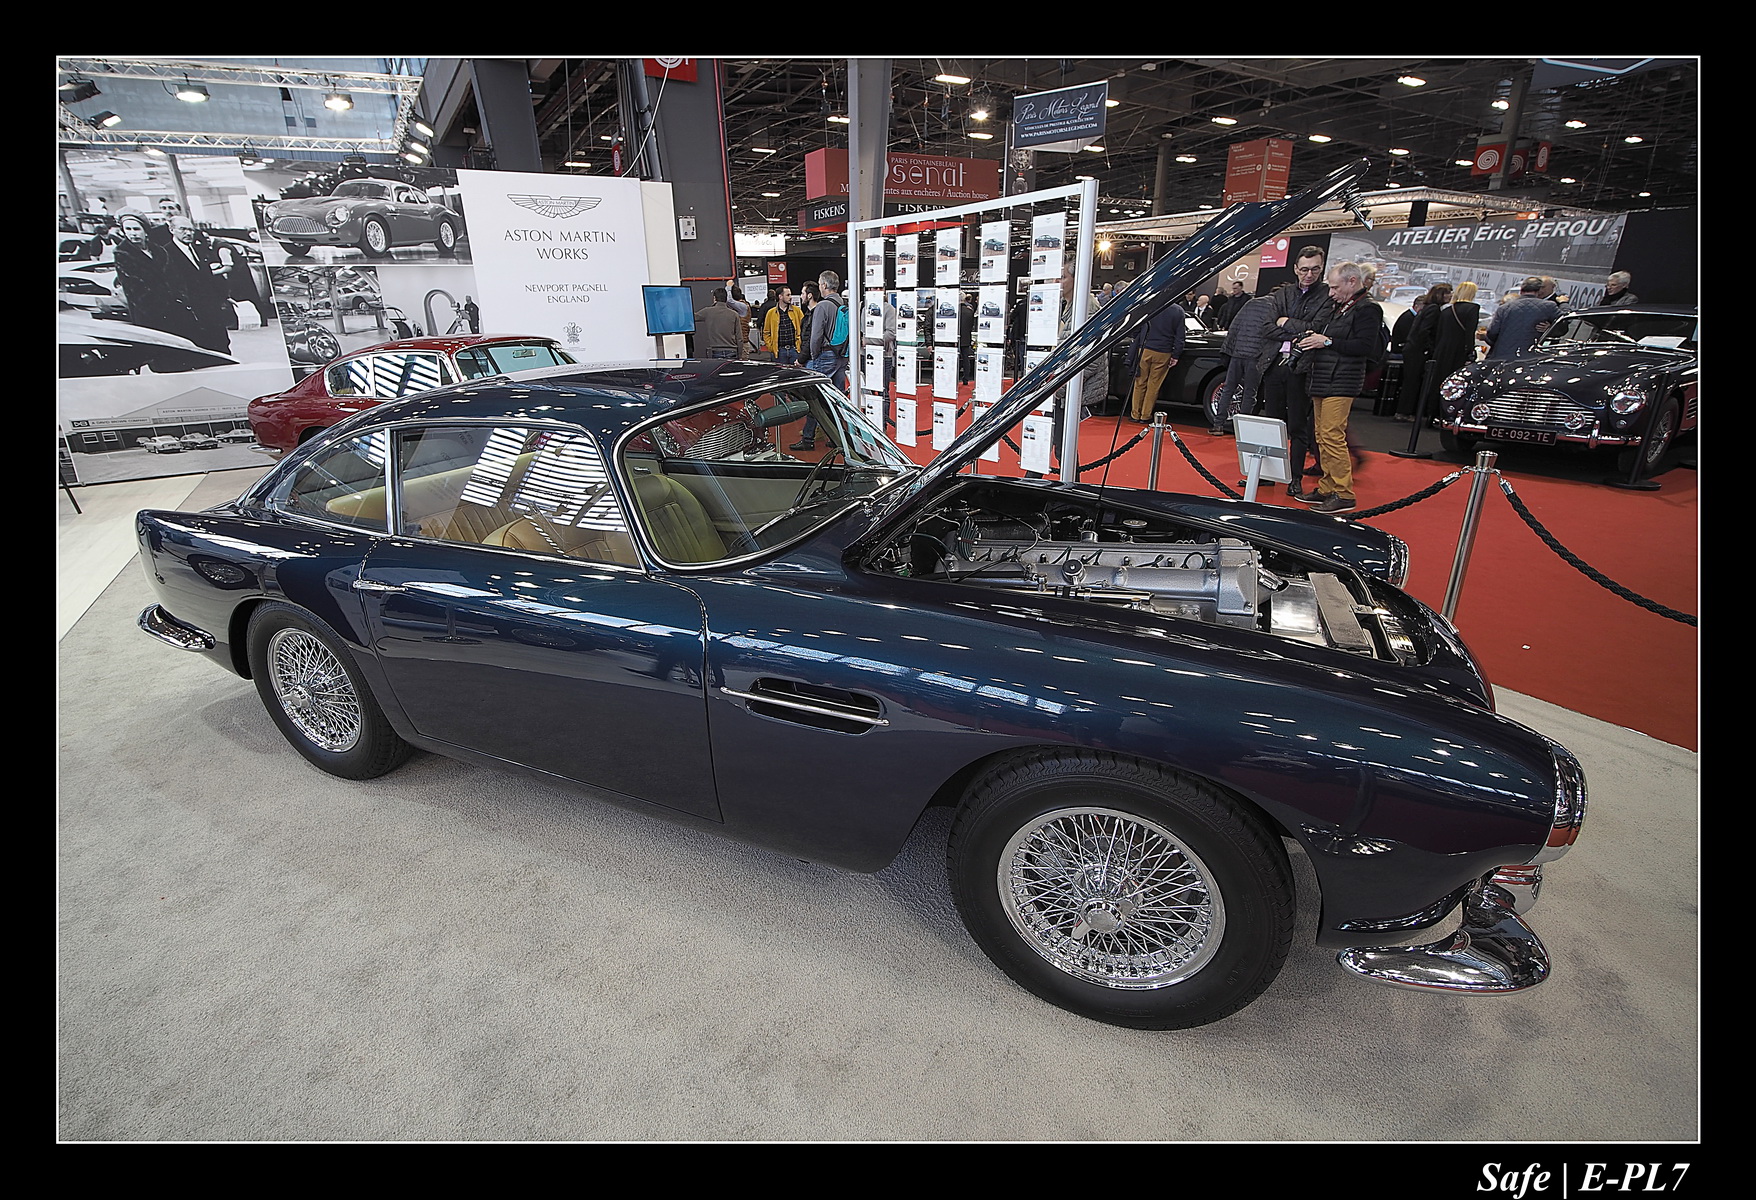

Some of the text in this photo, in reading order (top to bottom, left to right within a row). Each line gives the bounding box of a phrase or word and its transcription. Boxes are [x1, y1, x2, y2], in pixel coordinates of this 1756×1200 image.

[890, 157, 957, 168] PARIS FONTAINEBLEAU
[914, 188, 941, 198] enchères
[946, 190, 971, 199] Auction
[971, 191, 990, 200] house
[813, 203, 846, 221] FISKENS
[504, 229, 616, 243] ASTON MARTIN
[1387, 227, 1472, 247] ATELIER
[1521, 218, 1609, 240] PEROU
[536, 247, 589, 261] WORKS
[525, 283, 609, 293] NEWPORT PAGNELL
[547, 294, 590, 304] ENGLAND
[1491, 427, 1551, 443] CE-092-TE
